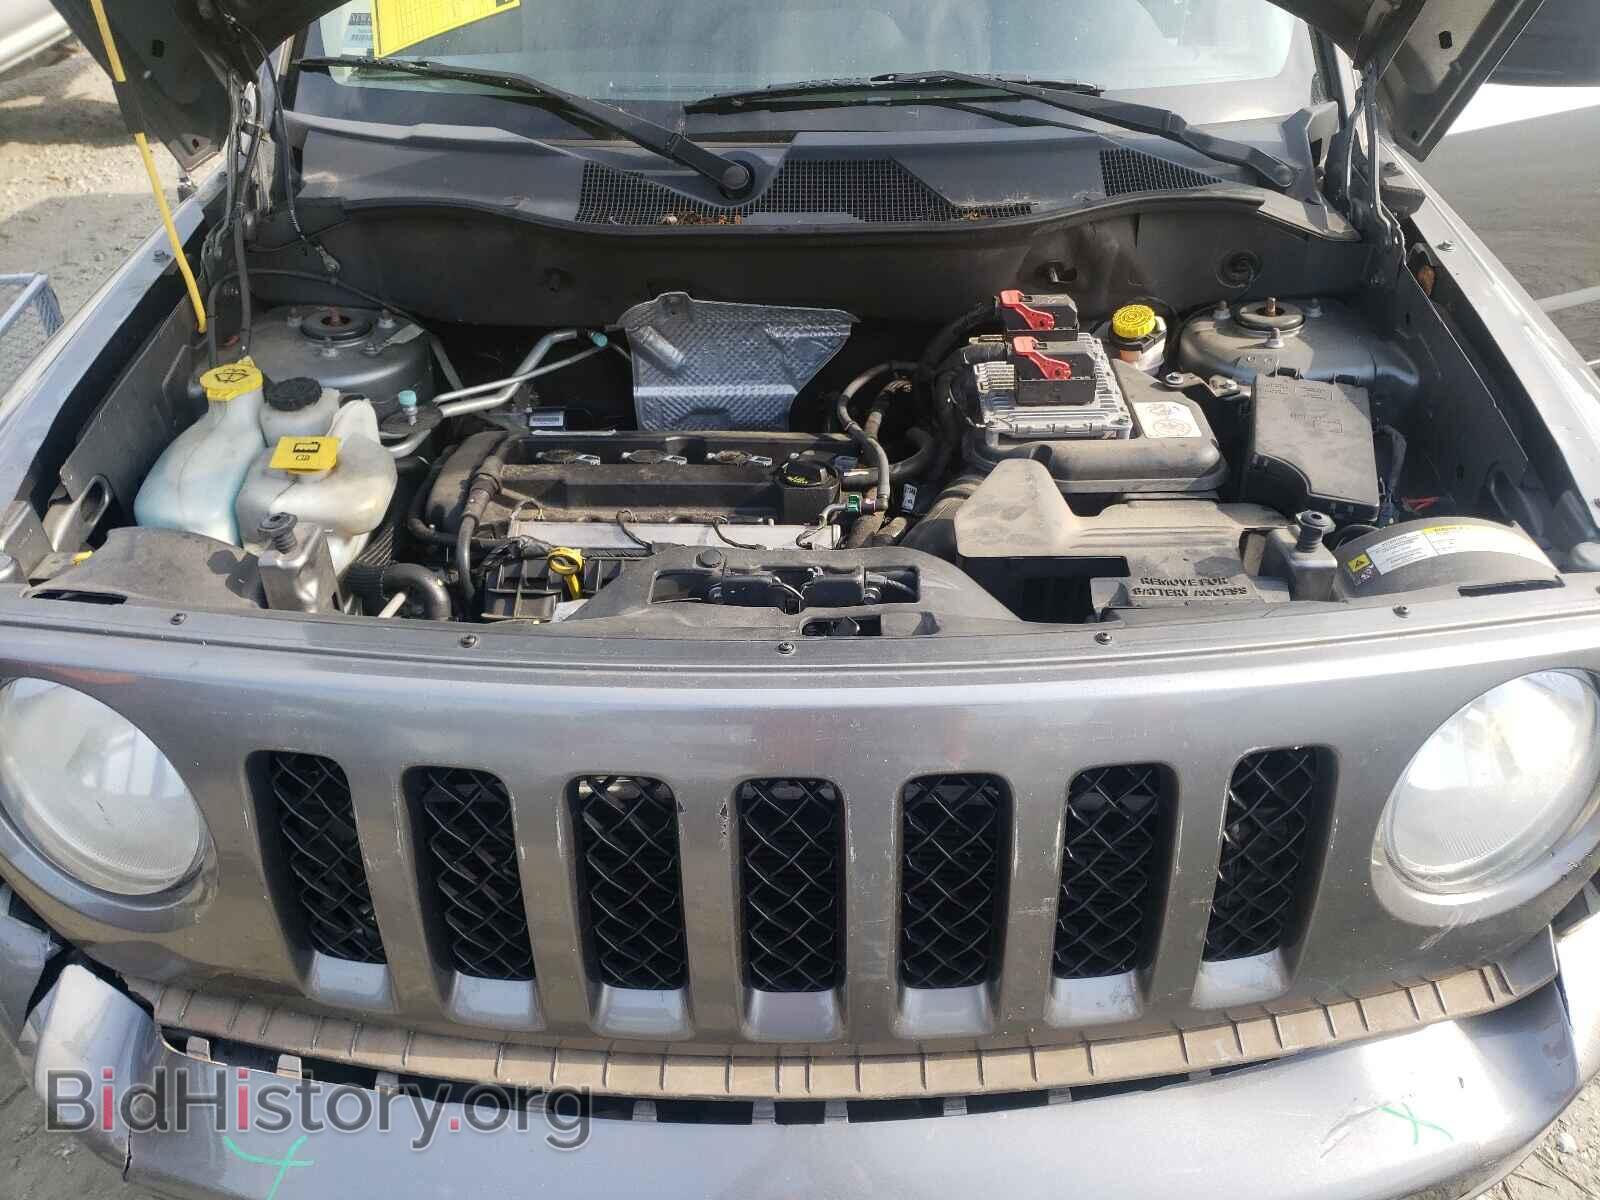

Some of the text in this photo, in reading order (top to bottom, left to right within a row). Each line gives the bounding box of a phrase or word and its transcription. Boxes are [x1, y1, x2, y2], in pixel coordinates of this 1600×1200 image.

[1140, 577, 1228, 587] REMOVE FOR
[1131, 587, 1248, 597] BATTERY ACCESS
